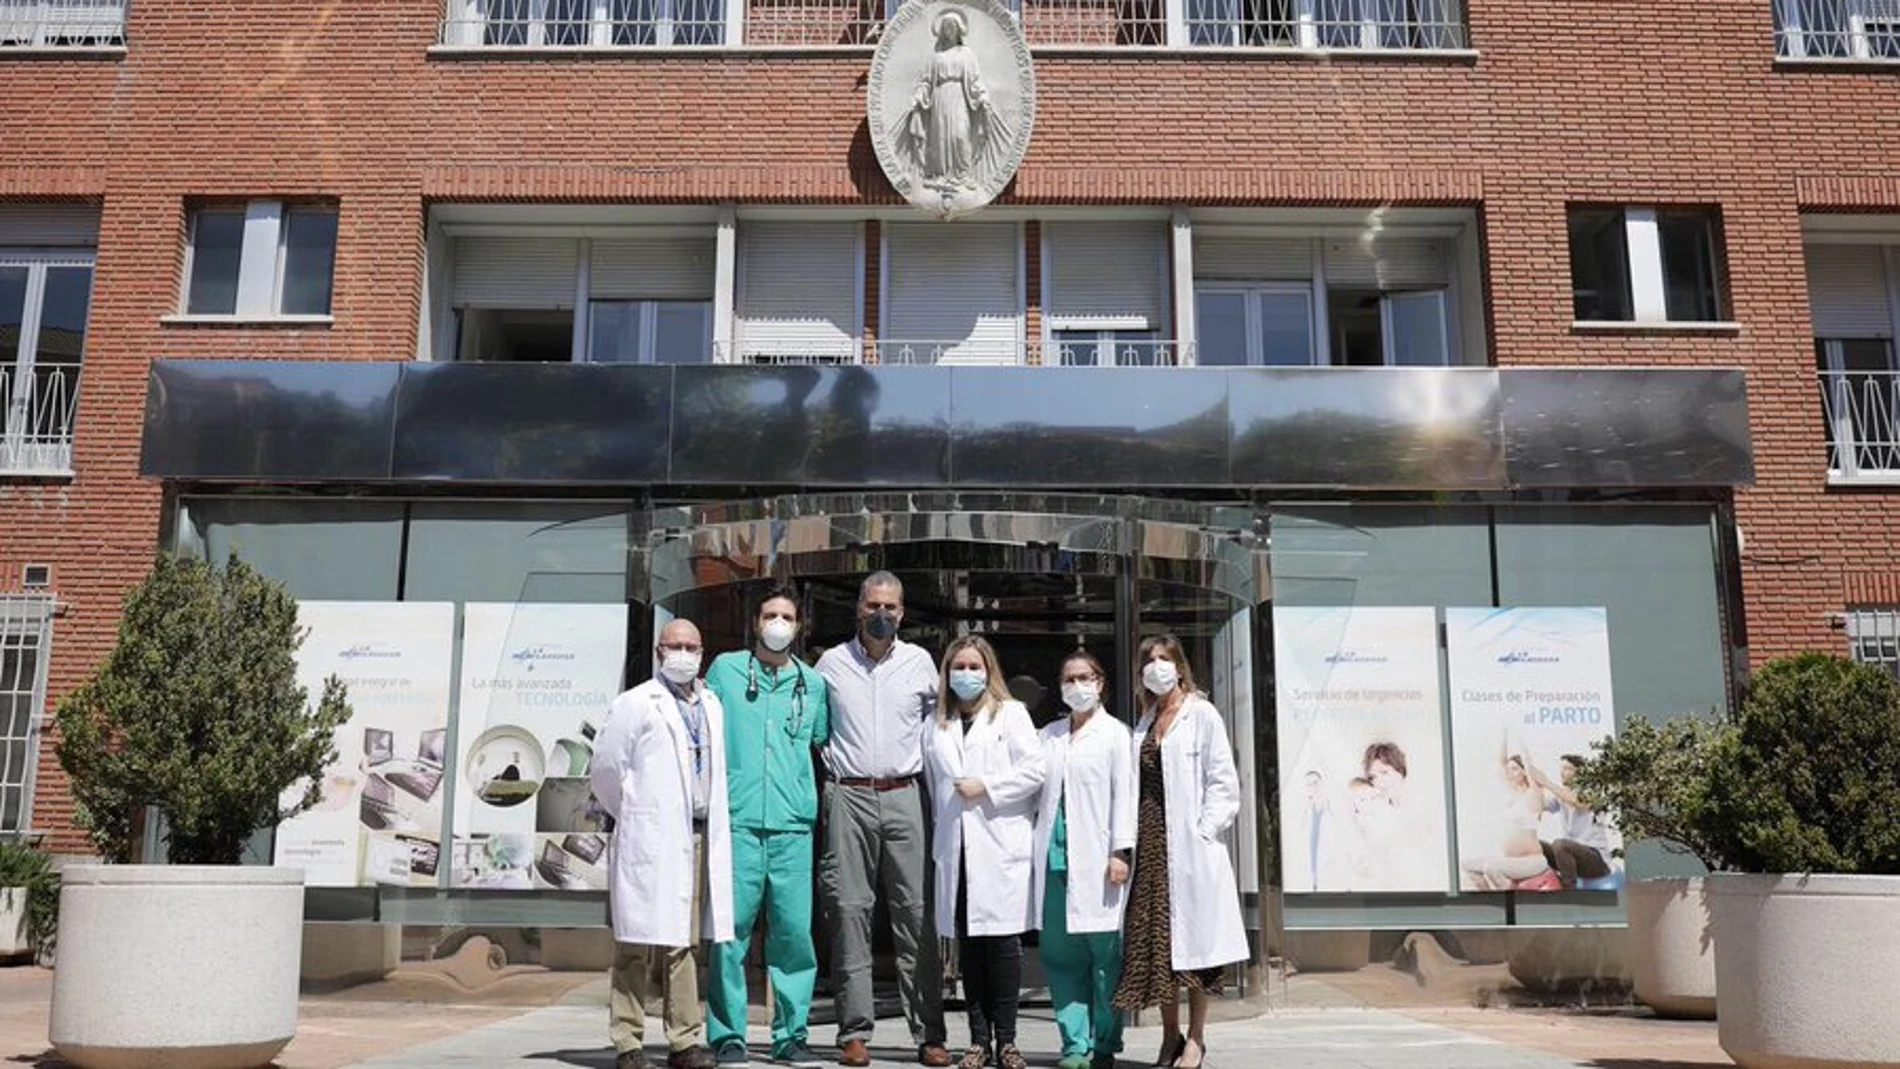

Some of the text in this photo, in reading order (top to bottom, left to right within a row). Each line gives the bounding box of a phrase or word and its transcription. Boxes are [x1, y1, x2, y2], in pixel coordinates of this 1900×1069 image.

[517, 678, 572, 690] avanzada
[1462, 690, 1601, 703] Clases de Preparación
[1524, 707, 1601, 724] al PARTO
